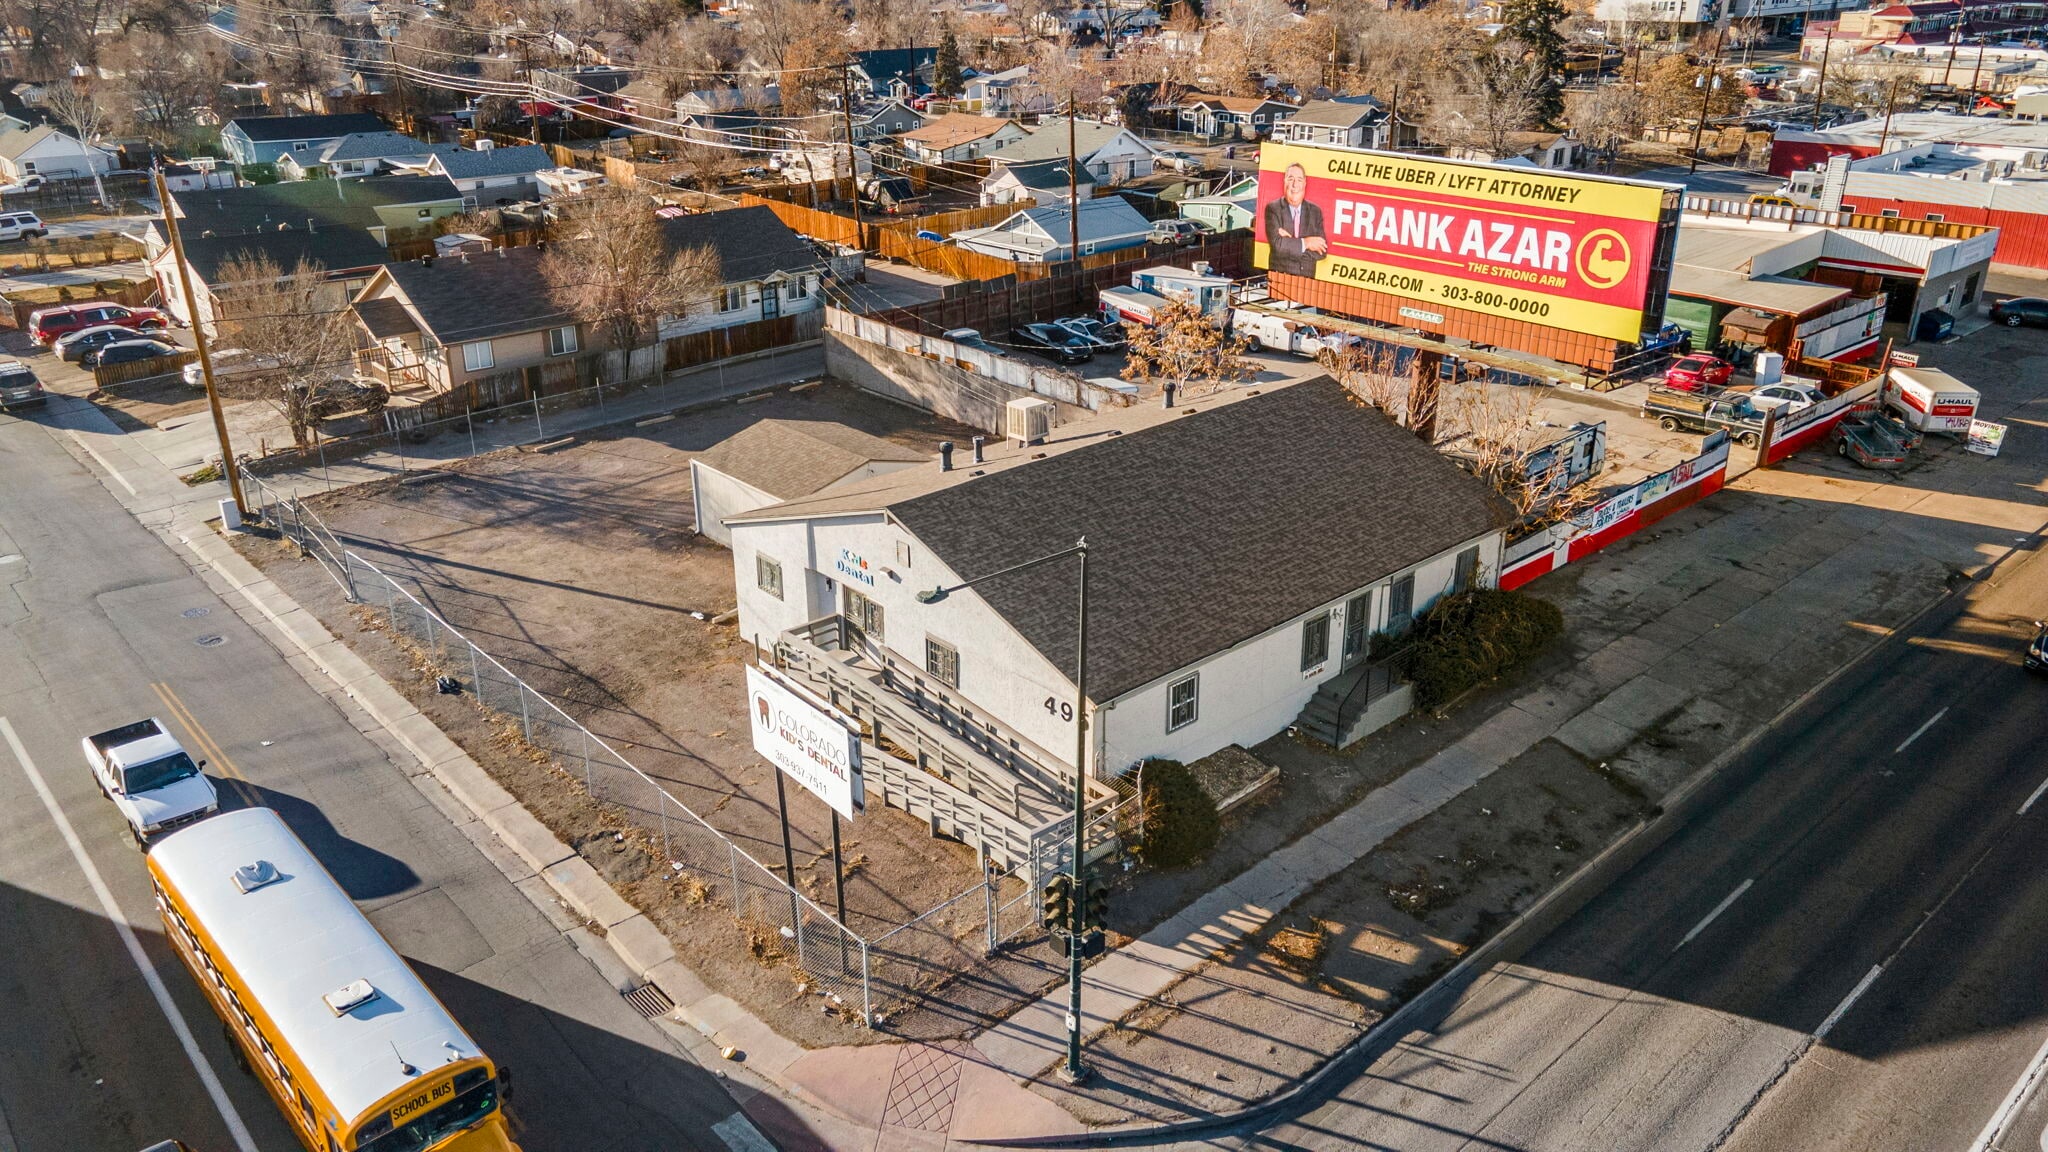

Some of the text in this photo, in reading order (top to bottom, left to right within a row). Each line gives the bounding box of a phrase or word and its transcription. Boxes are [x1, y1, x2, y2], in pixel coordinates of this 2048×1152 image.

[1328, 159, 1582, 204] CALL THE UBER / LYFT ATTORNEY
[1333, 199, 1572, 273] FRANK AZAR
[1331, 263, 1424, 293] FDAZAR.COM
[1441, 284, 1550, 318] 303-800-0000
[1467, 261, 1567, 289] THE STRONG ARM
[835, 559, 874, 587] Dental
[778, 710, 846, 766] COLORADO
[779, 726, 848, 783] KID'S DENTAL
[392, 1082, 452, 1120] SCHOOL BUS
